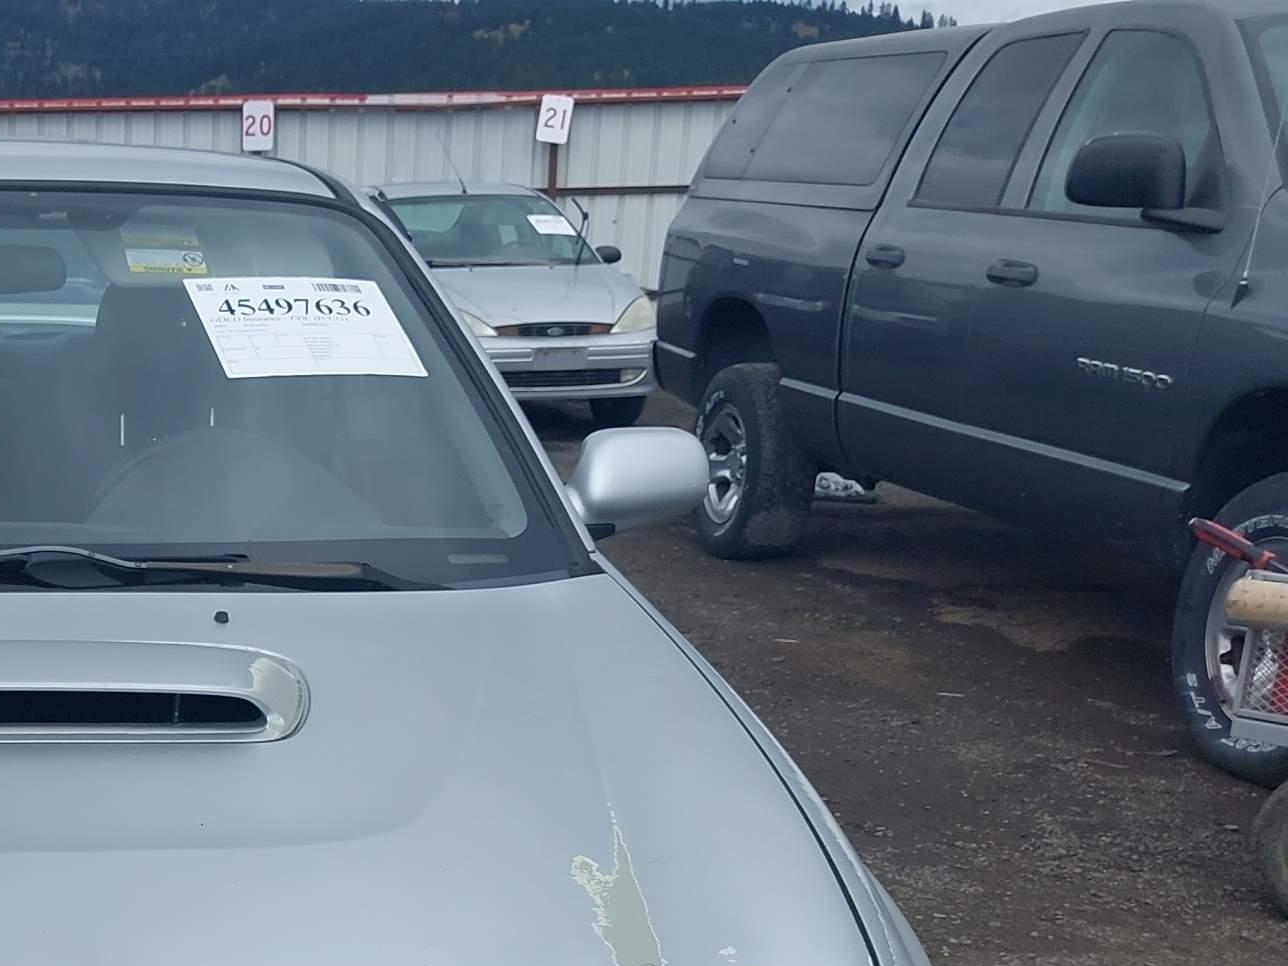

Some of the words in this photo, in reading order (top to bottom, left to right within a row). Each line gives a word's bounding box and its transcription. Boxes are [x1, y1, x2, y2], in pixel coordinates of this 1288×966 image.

[244, 114, 272, 137] 20
[543, 107, 567, 130] 21
[218, 297, 372, 317] 45497636
